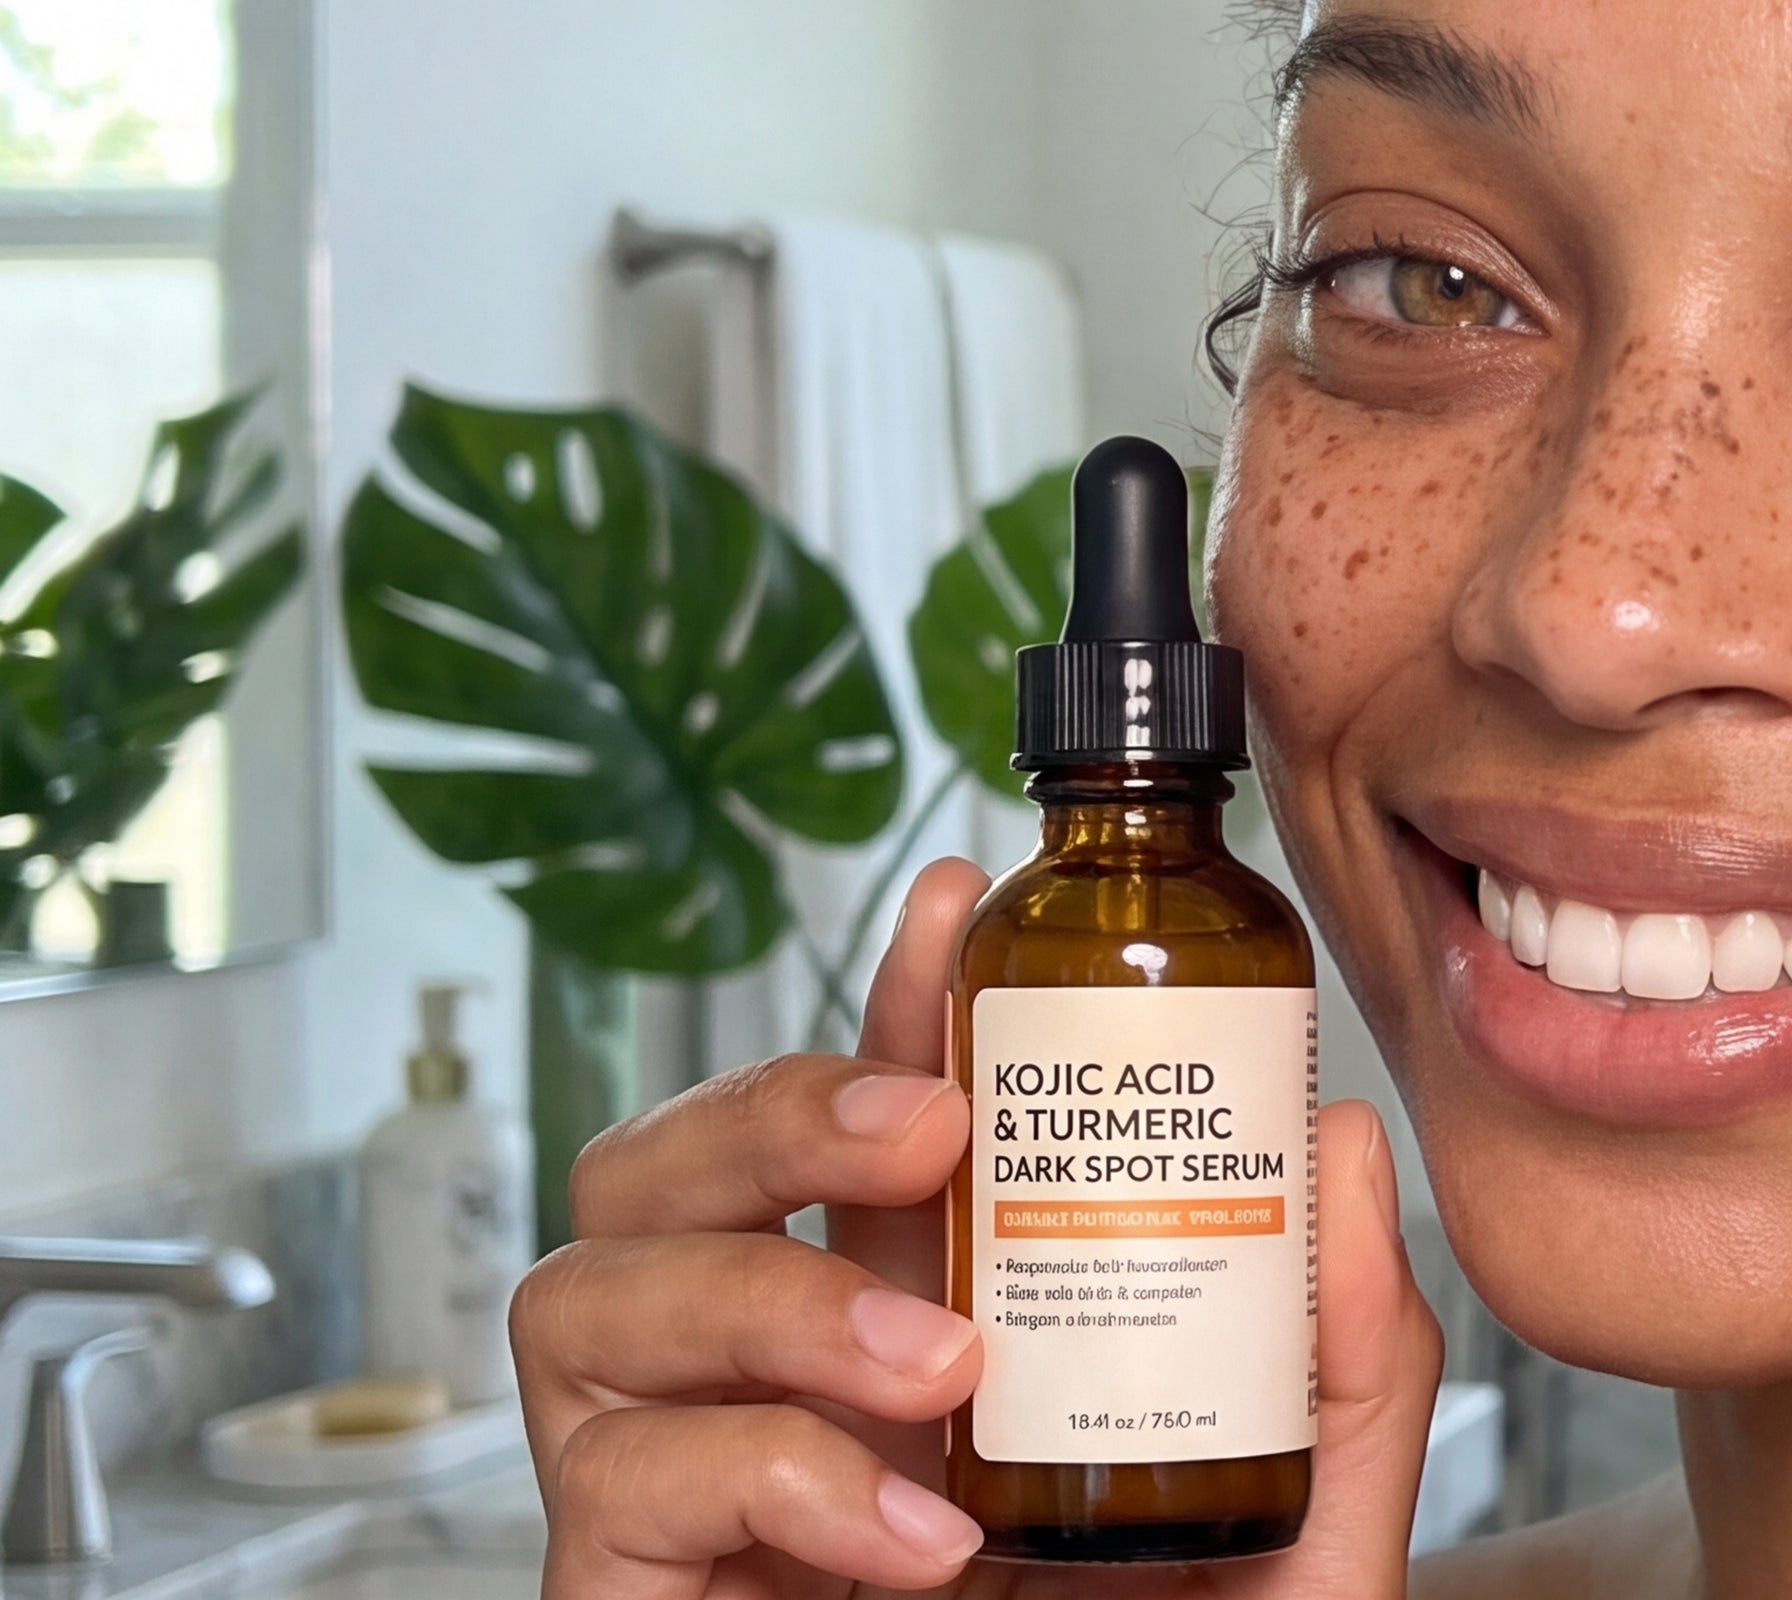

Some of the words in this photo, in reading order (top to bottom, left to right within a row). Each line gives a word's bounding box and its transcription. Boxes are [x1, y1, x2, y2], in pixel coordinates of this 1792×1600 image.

[995, 1063, 1104, 1096] KOJIC
[1114, 1063, 1215, 1096] ACID
[994, 1108, 1018, 1141] &
[1025, 1107, 1233, 1141] TURMERIC
[994, 1155, 1077, 1183] DARK
[1084, 1155, 1175, 1183] SPOT
[1182, 1152, 1284, 1182] SERUM
[1115, 1418, 1135, 1430] oz
[1196, 1410, 1217, 1427] ml
